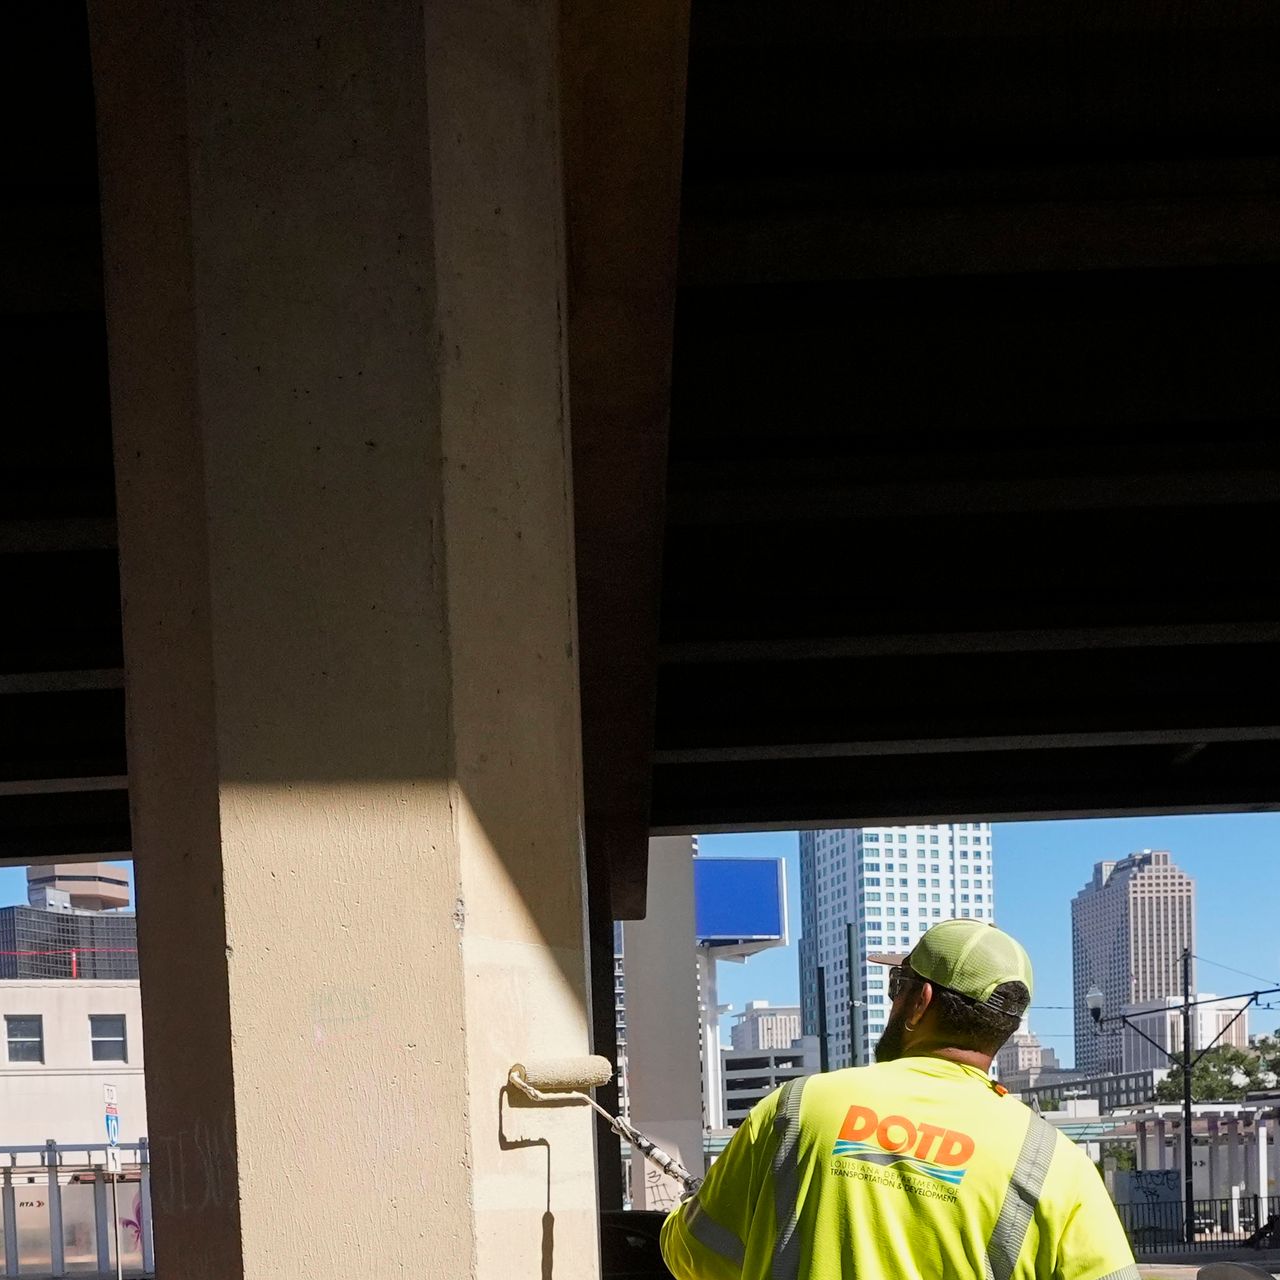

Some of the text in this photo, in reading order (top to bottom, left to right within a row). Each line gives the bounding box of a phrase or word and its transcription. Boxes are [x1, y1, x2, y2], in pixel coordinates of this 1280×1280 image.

[108, 1119, 118, 1141] 10
[837, 1105, 975, 1167] DOTD
[830, 1159, 960, 1196] LOUISIANA DEPARTMENT OF
[830, 1168, 895, 1189] TRANSPORTATION
[904, 1185, 958, 1204] DEVELOPMENT
[19, 1200, 34, 1208] RTA
